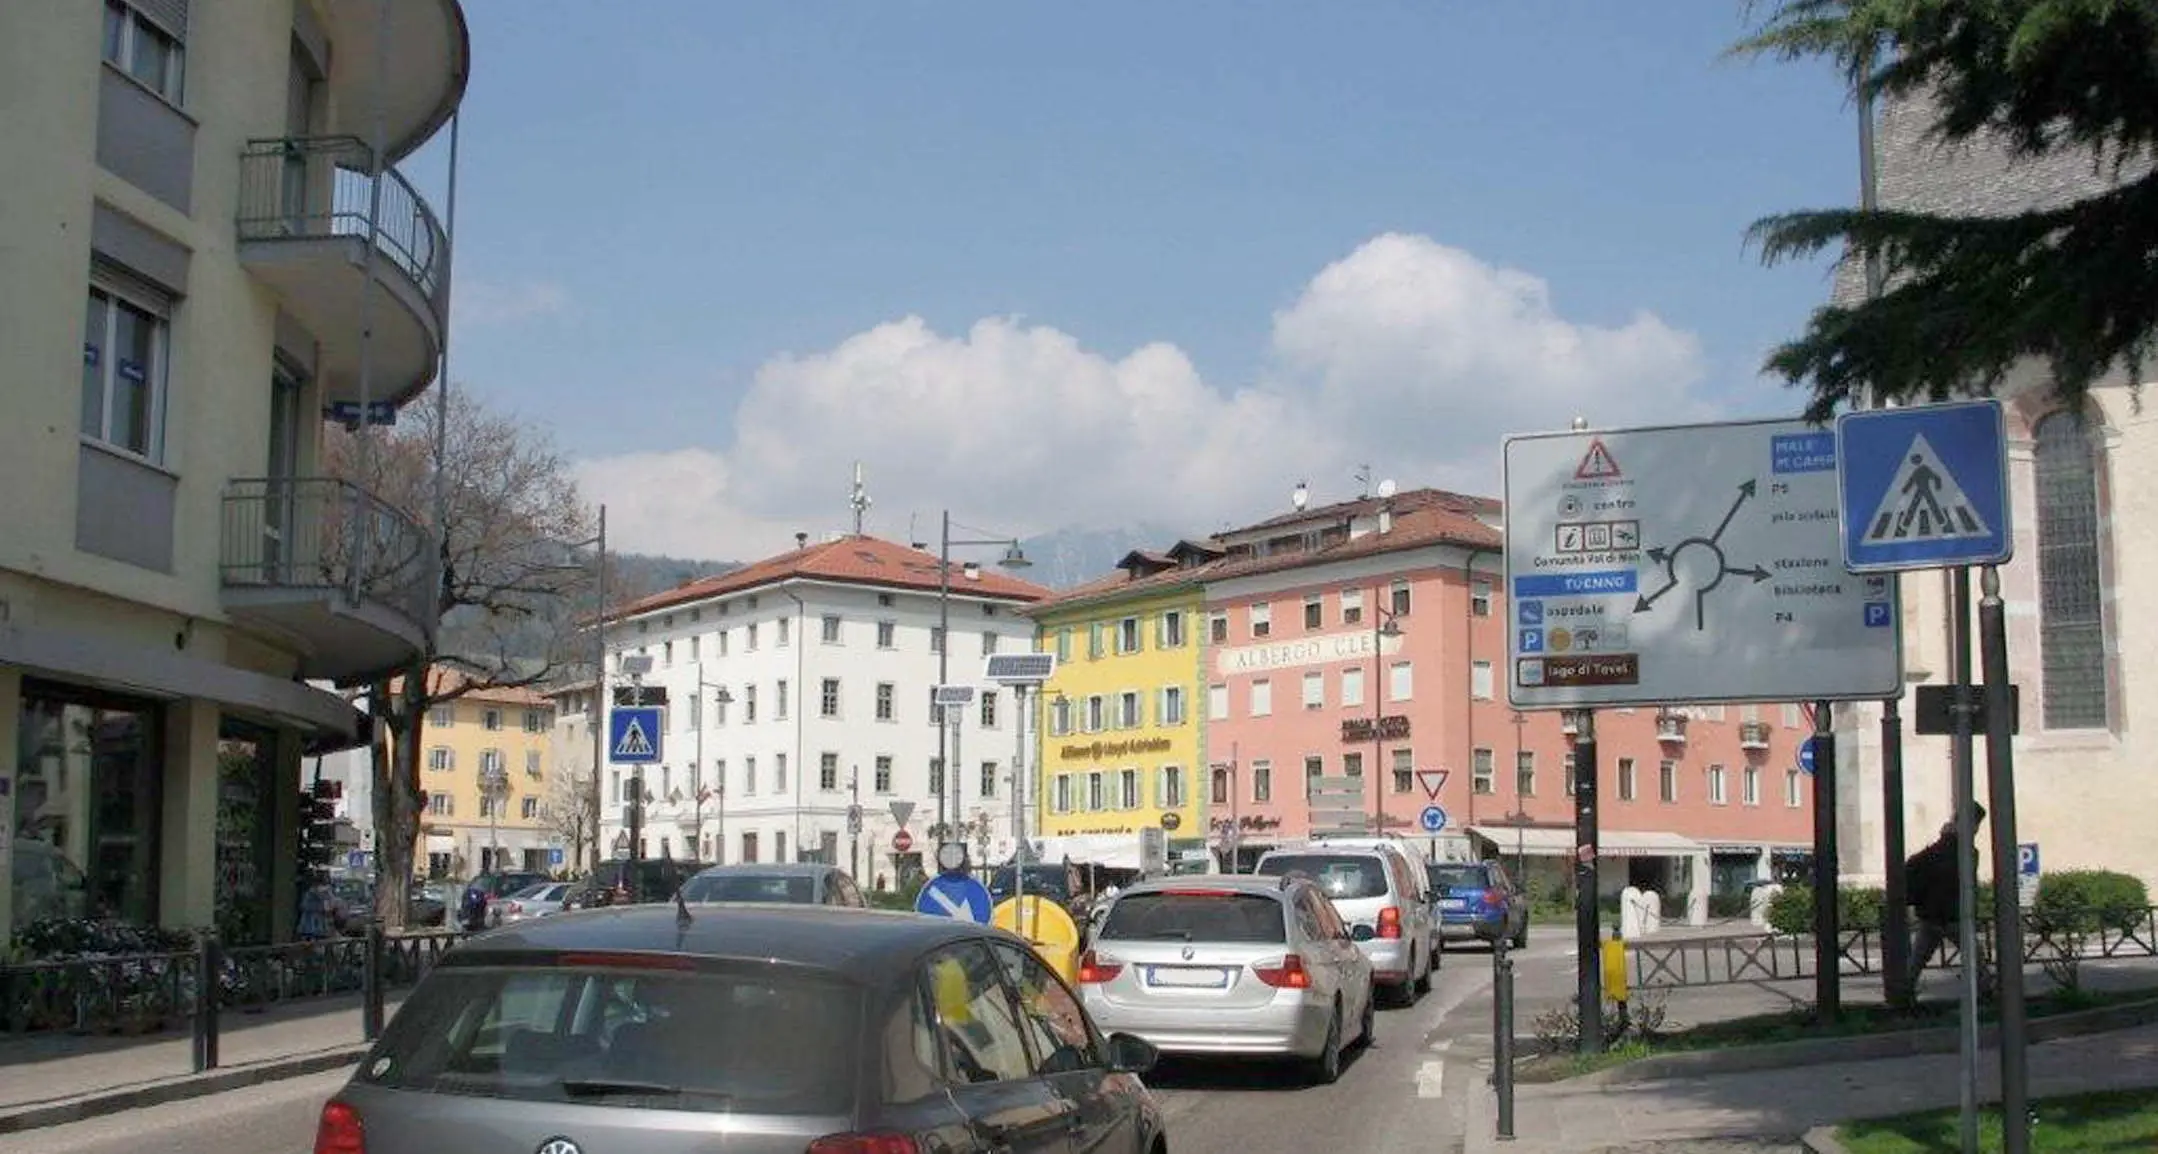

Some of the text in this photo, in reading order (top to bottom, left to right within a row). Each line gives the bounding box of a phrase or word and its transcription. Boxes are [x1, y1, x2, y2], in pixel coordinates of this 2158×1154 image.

[1594, 499, 1637, 511] centro
[1774, 557, 1829, 569] stazione
[1565, 576, 1626, 590] TUENNO
[1546, 604, 1605, 617] ospedale
[1869, 606, 1885, 624] P
[1524, 631, 1537, 650] P
[1235, 634, 1380, 669] ALBERGO CLE
[1548, 667, 1575, 679] lago
[1577, 665, 1591, 676] di
[2018, 847, 2033, 871] P
